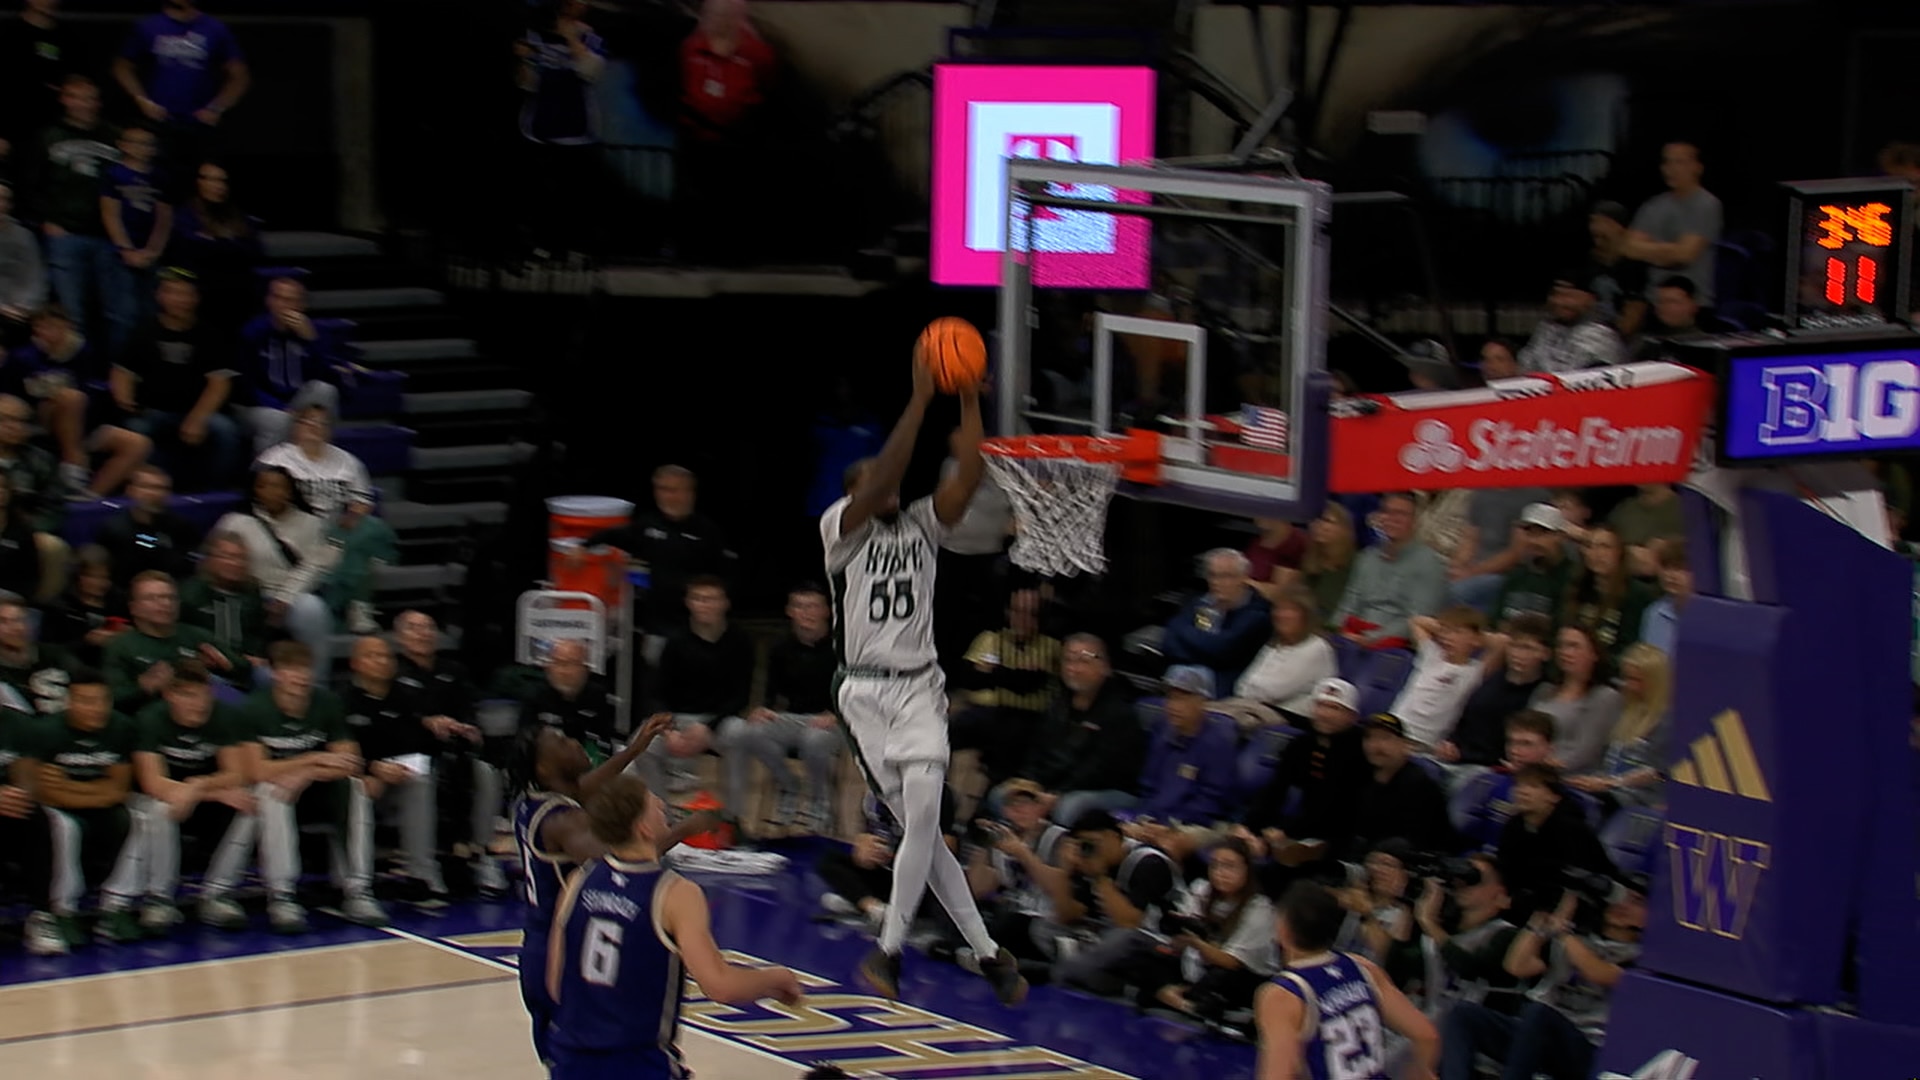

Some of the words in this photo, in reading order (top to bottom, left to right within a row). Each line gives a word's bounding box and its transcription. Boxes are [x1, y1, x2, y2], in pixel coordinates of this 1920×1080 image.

[1826, 255, 1876, 305] 11
[869, 576, 915, 622] 55
[1663, 822, 1771, 940] W
[581, 916, 624, 987] 6
[1320, 1003, 1386, 1080] 23
